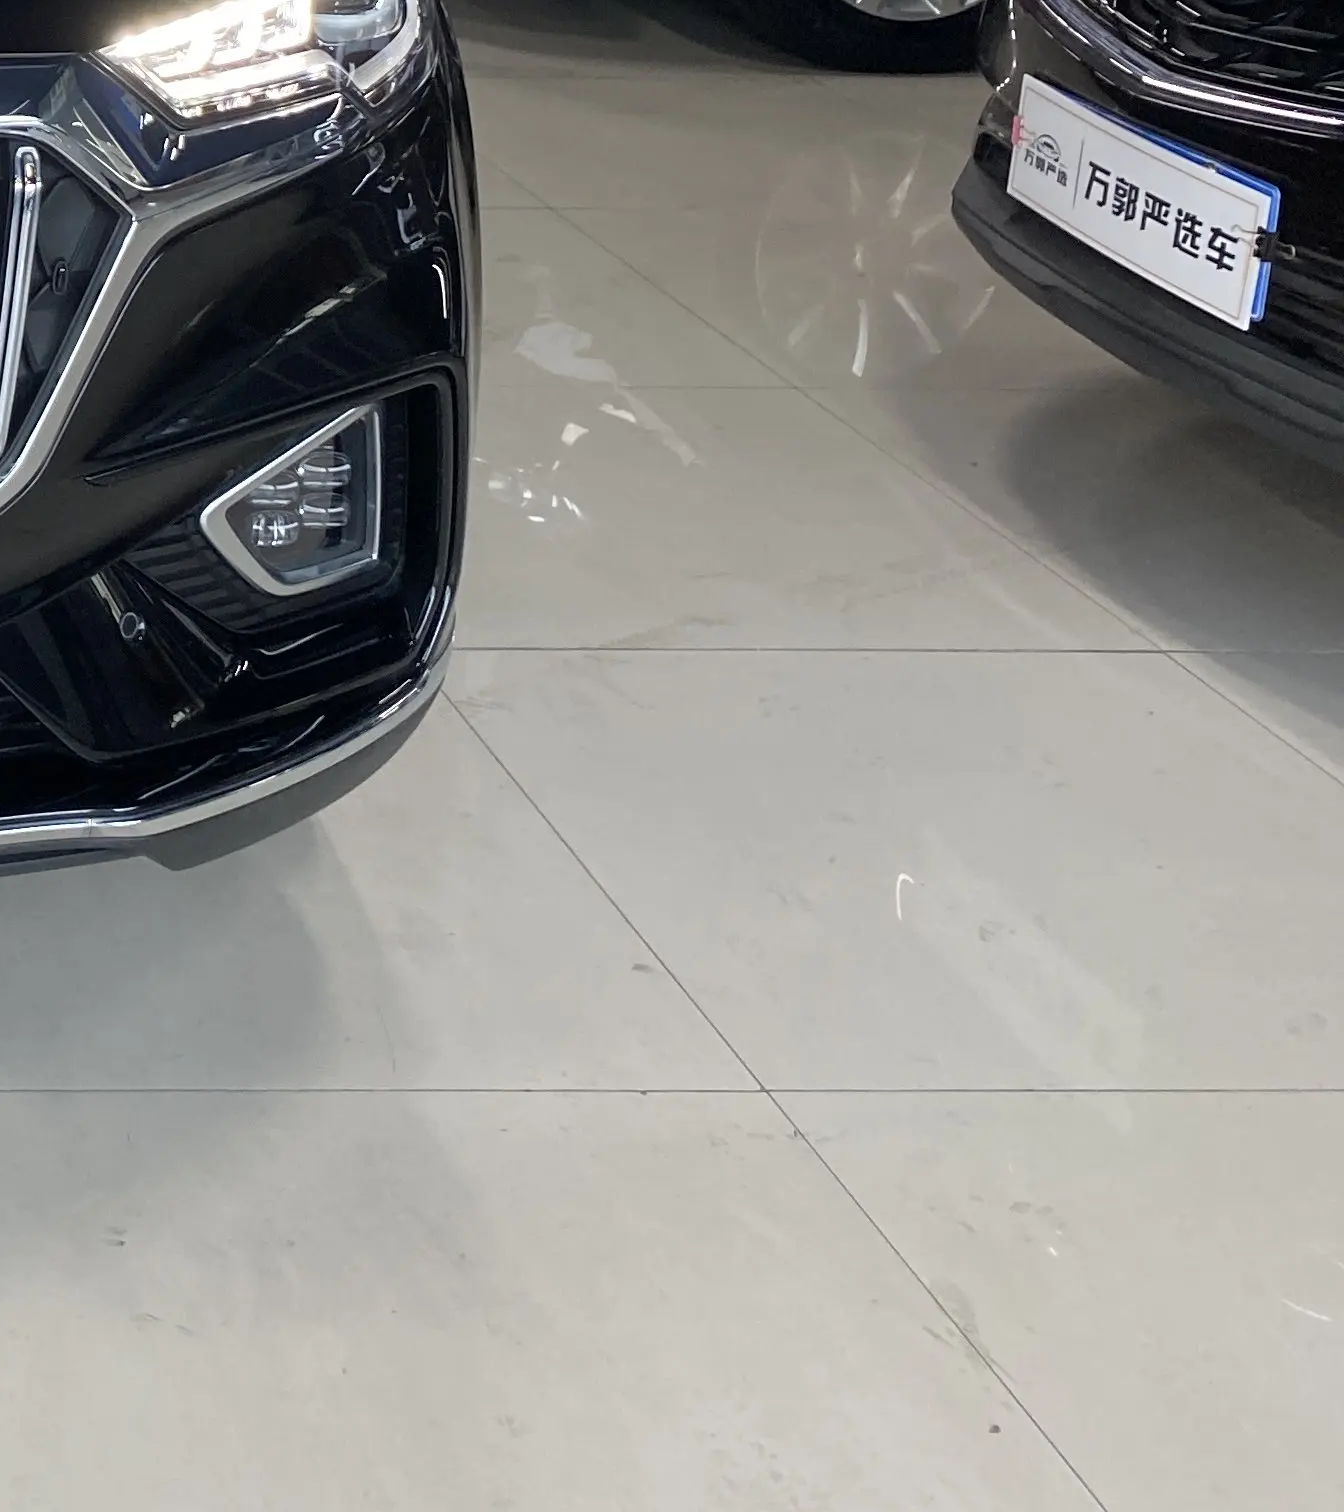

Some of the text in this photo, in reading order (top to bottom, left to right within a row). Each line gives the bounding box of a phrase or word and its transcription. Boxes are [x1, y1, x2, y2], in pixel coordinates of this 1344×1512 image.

[1023, 147, 1068, 188] 万郭严选
[1084, 160, 1240, 272] 万郭严选车
